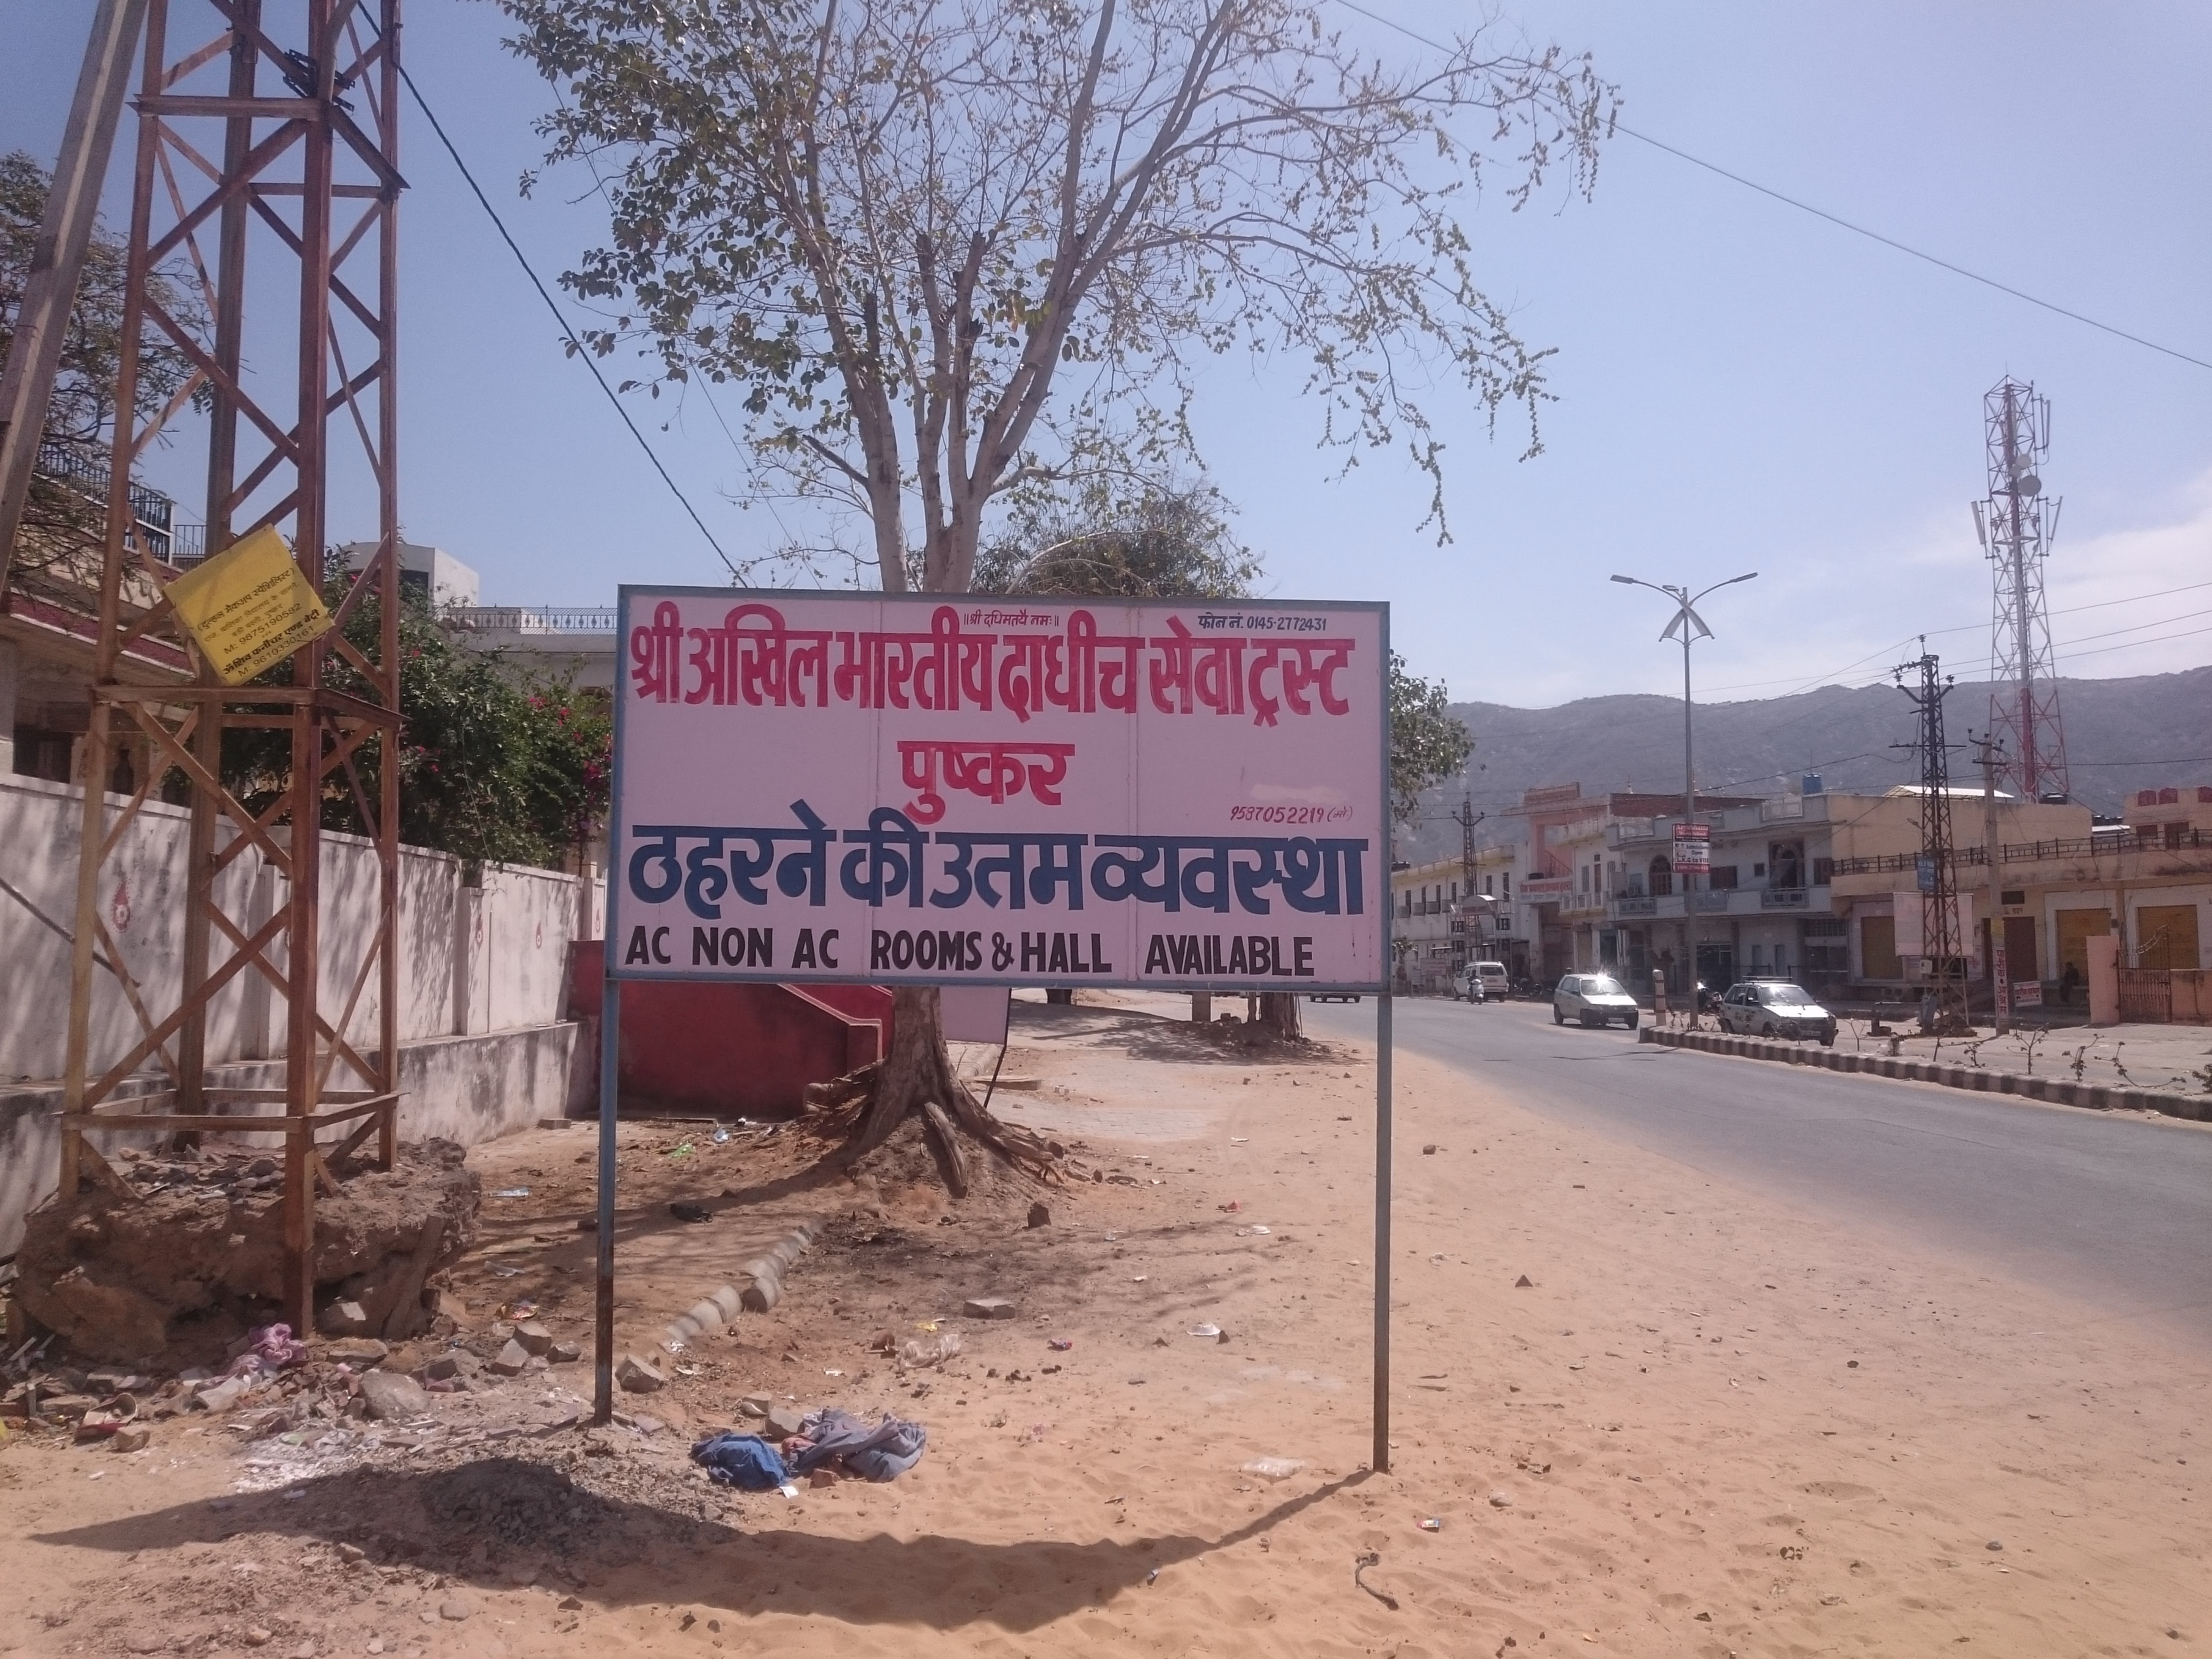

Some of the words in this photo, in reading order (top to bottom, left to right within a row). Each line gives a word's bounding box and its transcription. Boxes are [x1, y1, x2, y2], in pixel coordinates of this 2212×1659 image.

[270, 593, 278, 602] के
[1198, 612, 1228, 629] फोन
[1247, 616, 1327, 631] 0145-2772431
[224, 643, 238, 654] M:
[239, 603, 302, 645] 9875190582
[238, 666, 252, 677] M:
[253, 626, 315, 667] 9610330161
[630, 601, 684, 703] श्री
[684, 604, 833, 707] अखिल
[834, 605, 998, 711] भारतीय
[998, 609, 1145, 724] दाधीच
[1149, 615, 1247, 715] सेवा
[1248, 638, 1355, 728] ट्रस्ट
[897, 741, 1075, 825] पुष्कर
[1230, 805, 1324, 824] 9587052219
[628, 799, 837, 920] ठहरने
[840, 807, 929, 908] की
[1090, 834, 1369, 915] व्यवस्था
[625, 926, 671, 965] AC
[691, 927, 773, 967] NON
[791, 929, 839, 969] AC
[870, 930, 982, 971] ROOMS
[991, 931, 1014, 972] &
[1021, 931, 1112, 973] HALL
[1145, 934, 1315, 976] AVAILABLE
